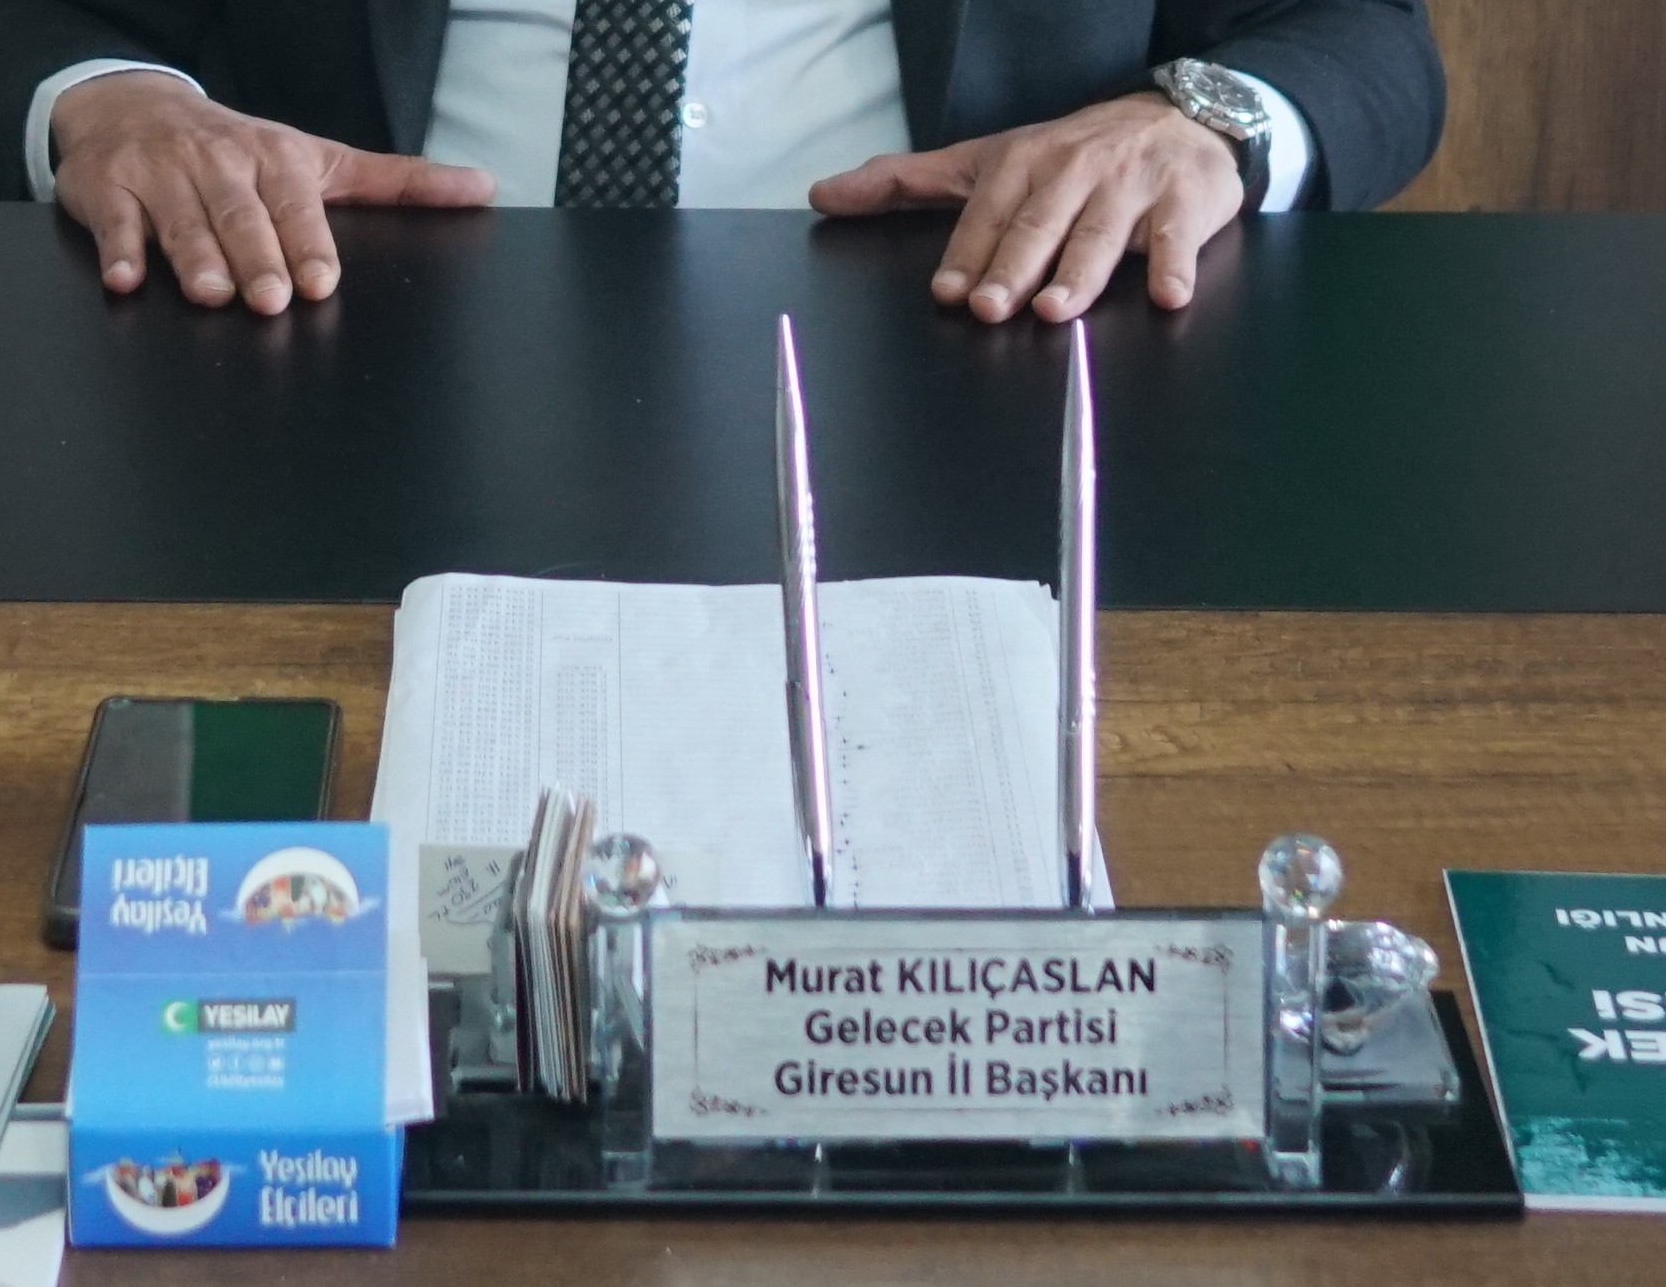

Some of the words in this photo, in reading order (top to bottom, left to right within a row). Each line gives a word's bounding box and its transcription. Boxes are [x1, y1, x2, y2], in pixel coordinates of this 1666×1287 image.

[765, 958, 883, 994] Murat
[897, 958, 1157, 999] KILIÇASLAN
[804, 1007, 972, 1044] Gelecek
[986, 1008, 1118, 1044] Partisi
[774, 1058, 934, 1097] Giresun
[946, 1052, 971, 1097] İl
[985, 1058, 1149, 1101] Başkanı
